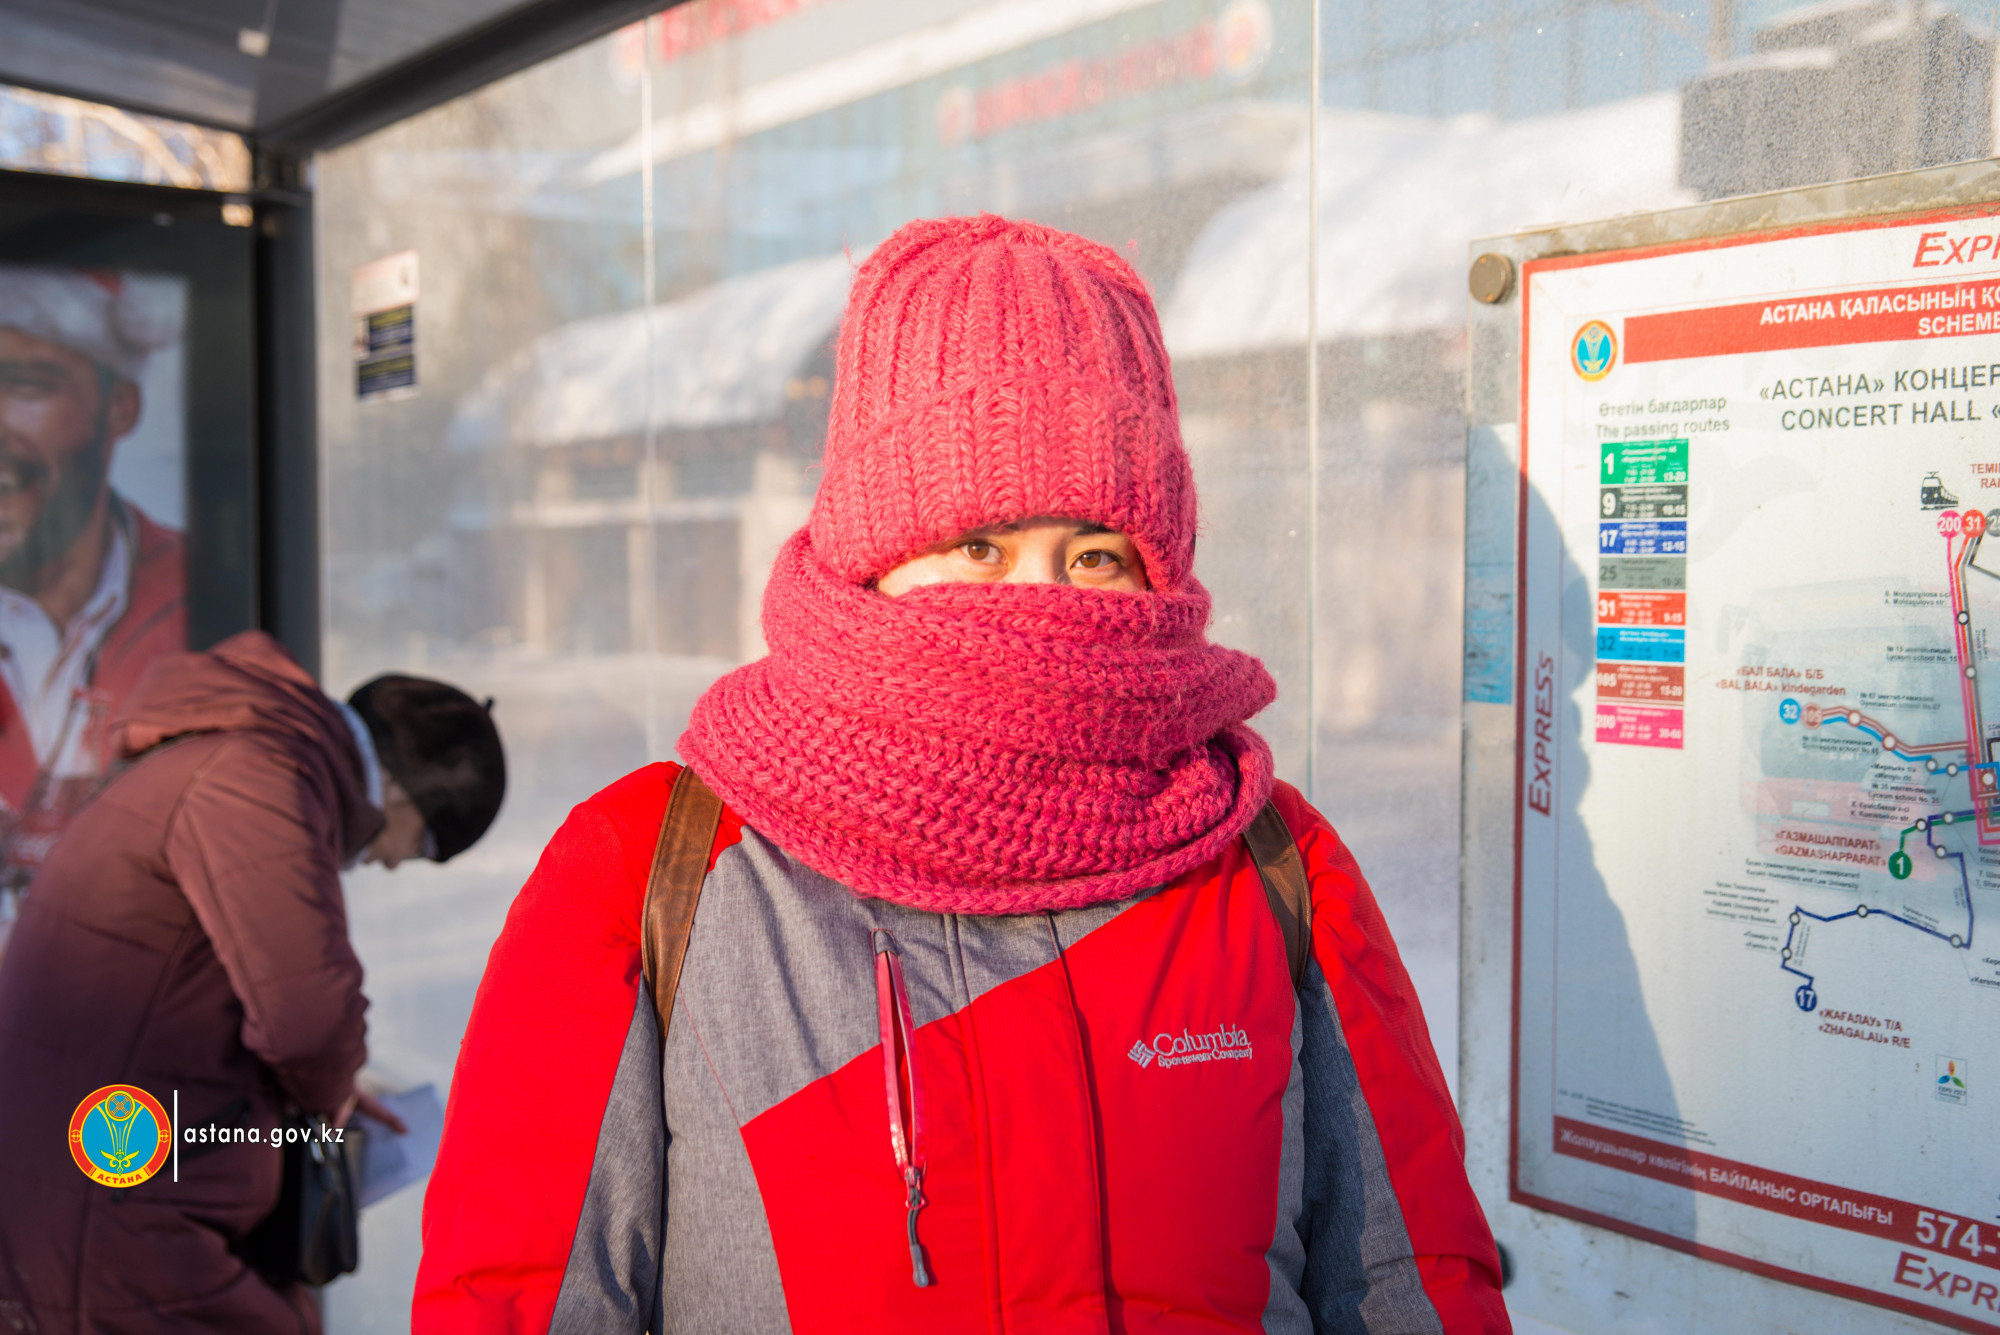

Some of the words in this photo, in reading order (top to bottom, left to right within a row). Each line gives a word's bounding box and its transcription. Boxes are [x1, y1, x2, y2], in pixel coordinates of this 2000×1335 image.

[1760, 301, 1836, 325] АСТАНА
[1840, 288, 1976, 320] ҚАЛАСЫНЫҢ
[1760, 372, 1885, 400] «АСТАНА»
[1781, 403, 1904, 431] CONCERT
[1912, 400, 1982, 424] HALL
[1595, 423, 1619, 438] The
[1624, 420, 1678, 440] passing
[1684, 417, 1731, 434] routes
[1604, 452, 1615, 475] 1
[1602, 492, 1616, 516] 9
[1939, 516, 1962, 532] 200
[1966, 516, 1980, 532] 31
[1600, 529, 1618, 548] 17
[1599, 565, 1617, 582] 25
[1598, 599, 1616, 617] 31
[1782, 682, 1846, 696] kindegarden
[1782, 704, 1798, 719] 32
[1896, 857, 1905, 875] 1
[1798, 989, 1815, 1008] 17
[1153, 1023, 1250, 1056] Columbia
[1819, 1022, 1890, 1045] «ZHAGALAU»
[1892, 1035, 1911, 1049] R/E
[1158, 1050, 1212, 1069] Sportswear
[1212, 1047, 1253, 1061] Company
[1710, 1166, 1796, 1203] БАЙЛАНЫС
[1800, 1191, 1893, 1225] ОРТАЛЫҒЫ
[1894, 1251, 2000, 1313] EXPR
